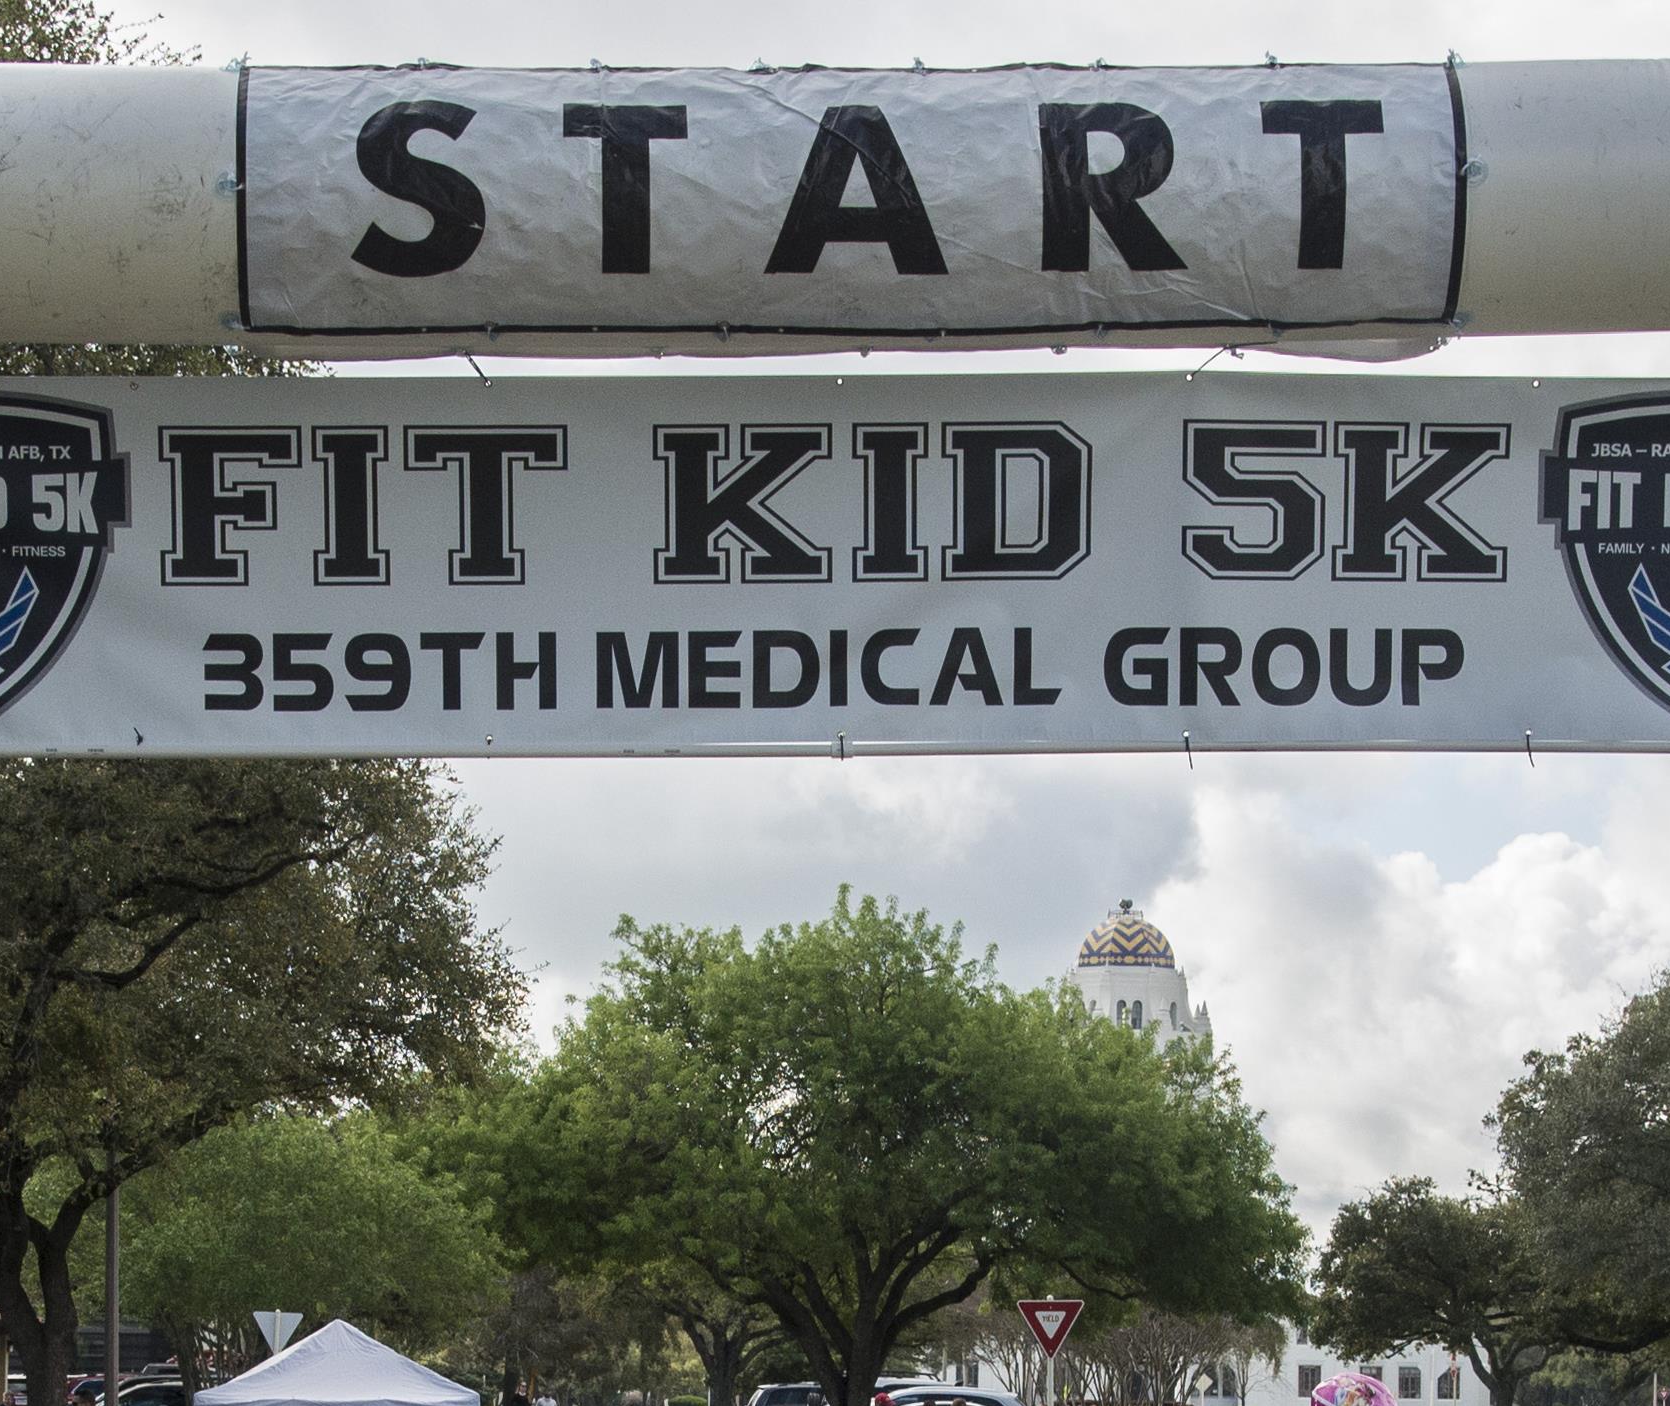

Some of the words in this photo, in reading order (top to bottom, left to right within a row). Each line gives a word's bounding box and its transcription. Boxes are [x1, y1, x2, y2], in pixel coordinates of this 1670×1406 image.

[350, 98, 1384, 279] START
[8, 445, 45, 462] AFB,
[48, 446, 72, 460] TX
[1591, 443, 1633, 458] JBSA
[31, 471, 99, 535] 5K
[159, 424, 568, 586] FIT
[652, 422, 1093, 585] KID
[1181, 418, 1512, 582] 5K
[1568, 468, 1642, 532] FIT
[11, 545, 67, 558] FITNESS
[1598, 543, 1645, 555] FAMILY
[201, 631, 558, 713] 359TH
[595, 625, 1063, 709] MEDICAL
[1102, 625, 1466, 707] GROUP
[1042, 1315, 1060, 1323] YIELD
